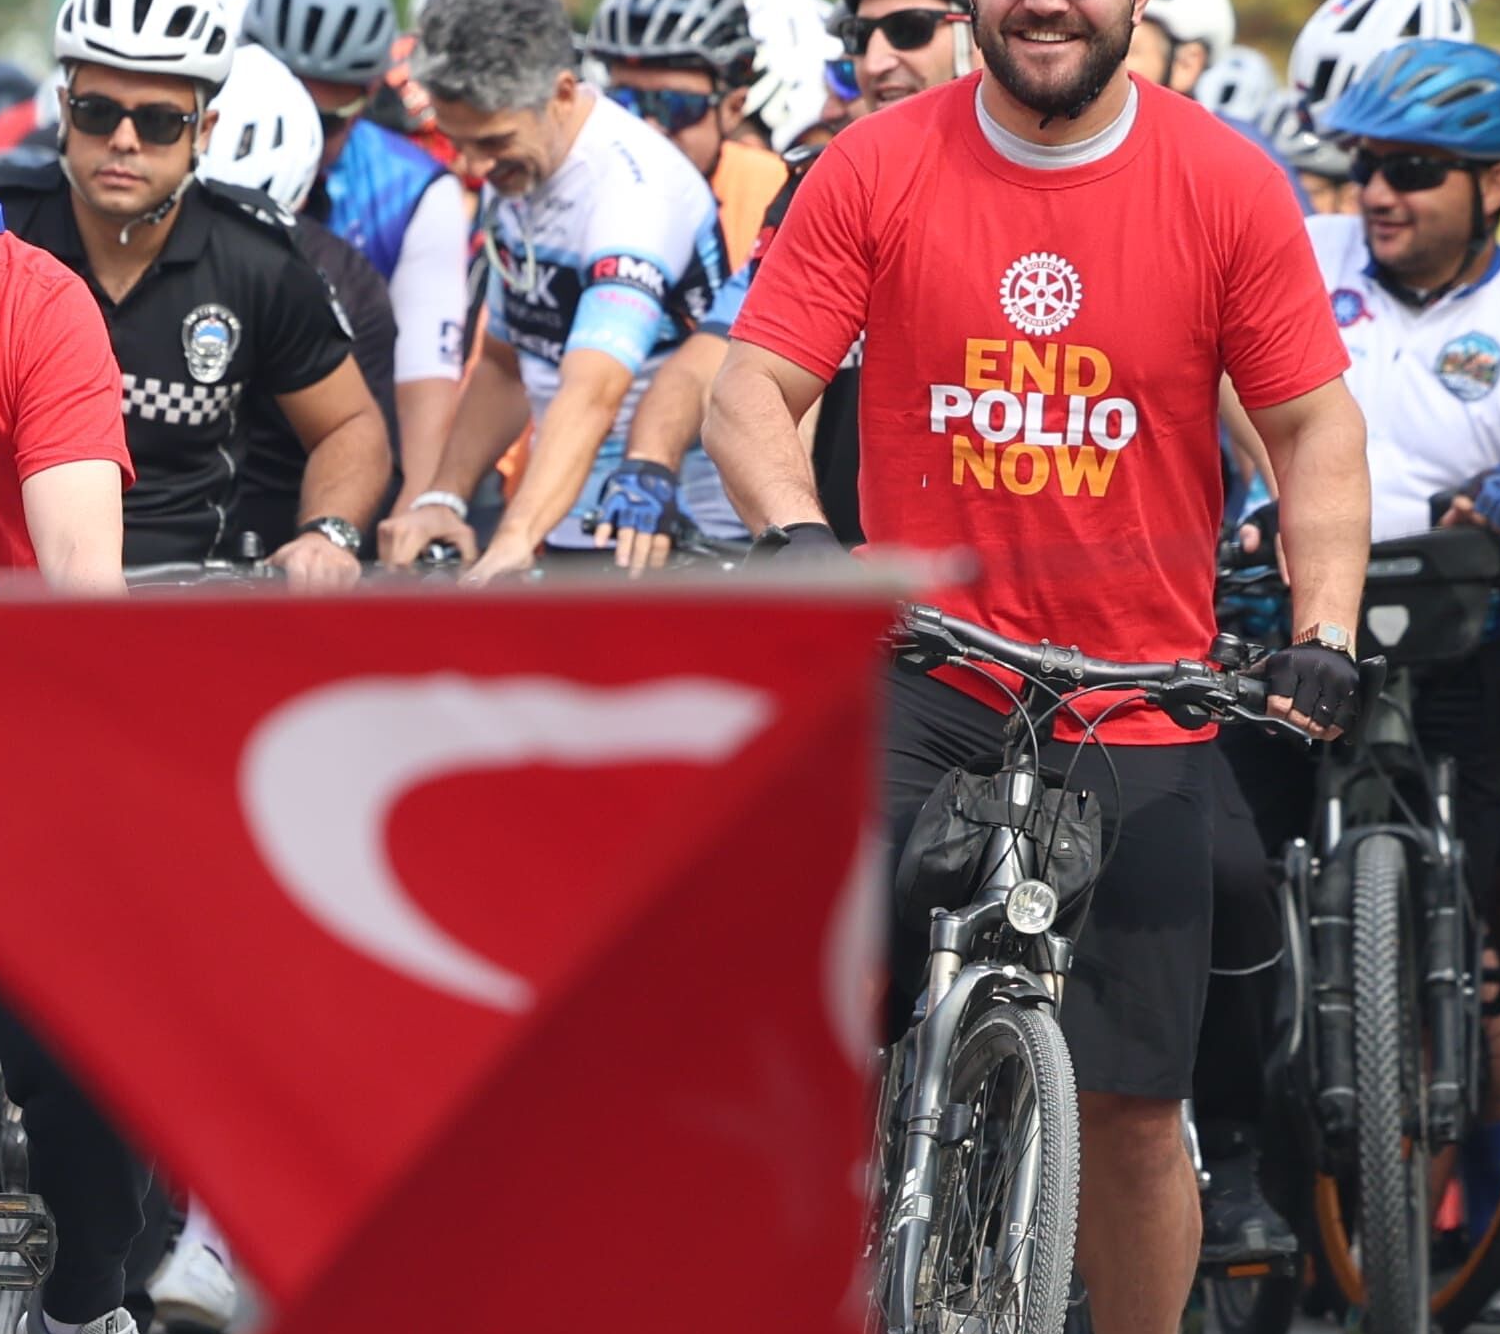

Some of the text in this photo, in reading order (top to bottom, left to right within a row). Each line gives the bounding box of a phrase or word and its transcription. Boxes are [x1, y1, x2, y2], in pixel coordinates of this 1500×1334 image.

[964, 338, 1112, 399] END
[929, 384, 1138, 451] POLIO
[951, 433, 1123, 498] NOW
